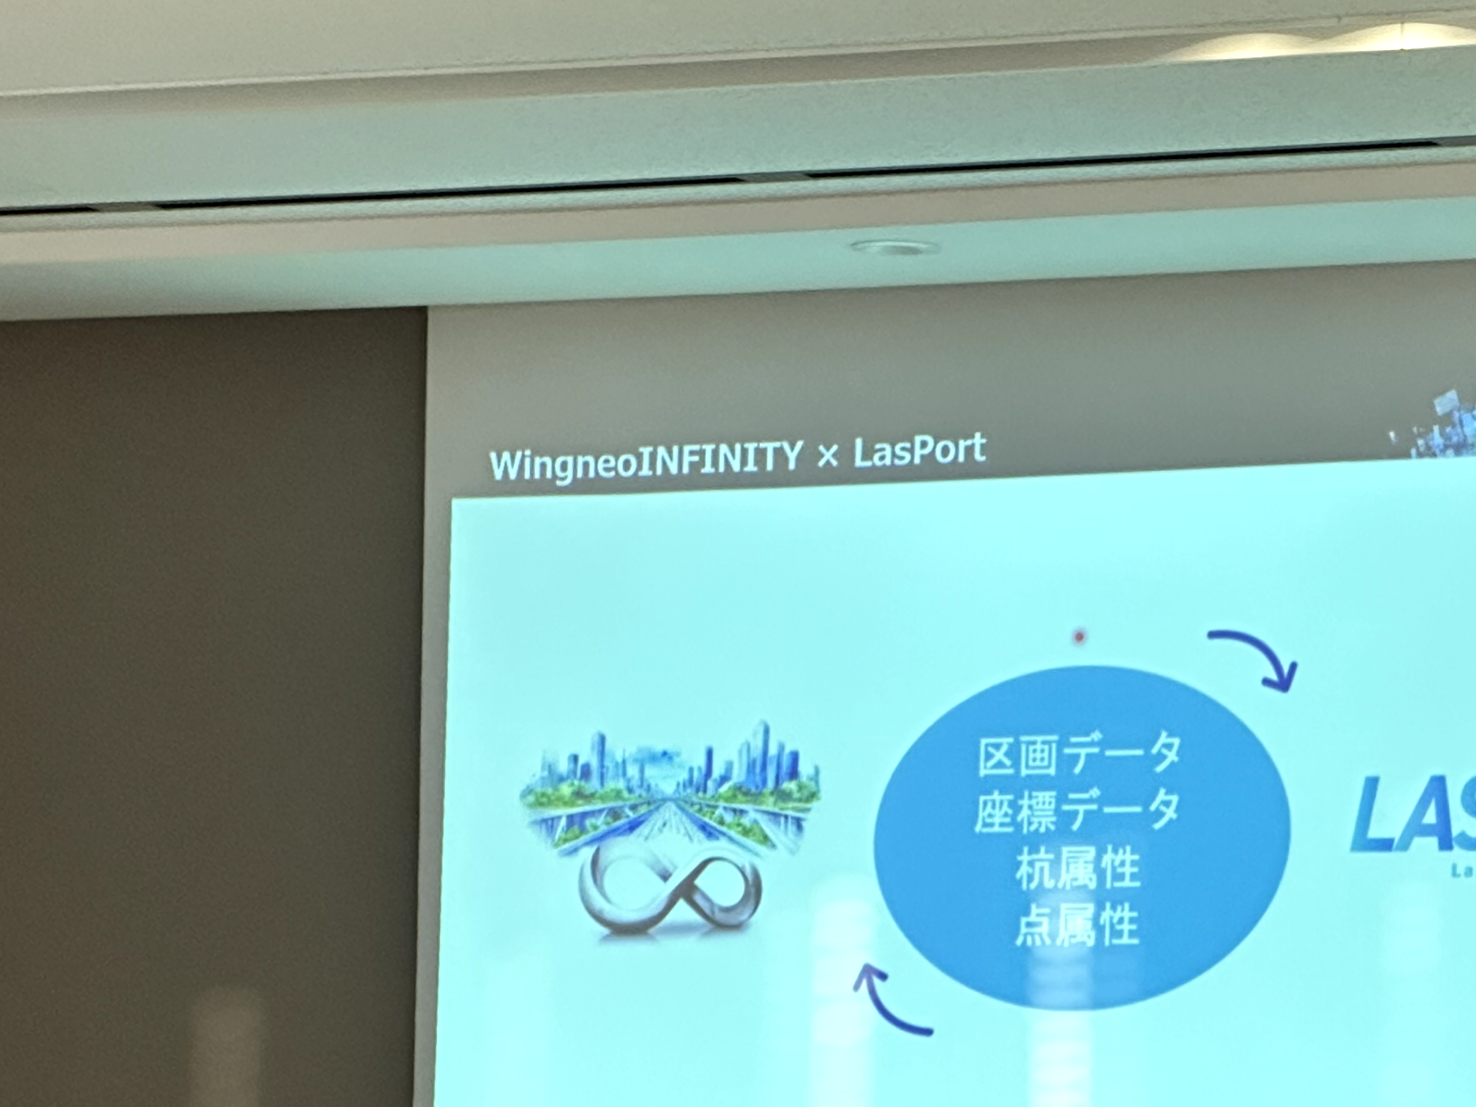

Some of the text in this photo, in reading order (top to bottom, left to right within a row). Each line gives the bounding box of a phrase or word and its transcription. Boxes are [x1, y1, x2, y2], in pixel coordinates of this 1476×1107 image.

[489, 439, 804, 486] WingneoINFINITY
[854, 431, 987, 468] LasPort
[978, 730, 1182, 777] 区画データ
[974, 787, 1180, 834] 座標データ
[1015, 844, 1141, 891] 杭属性
[1015, 902, 1140, 947] 点属性
